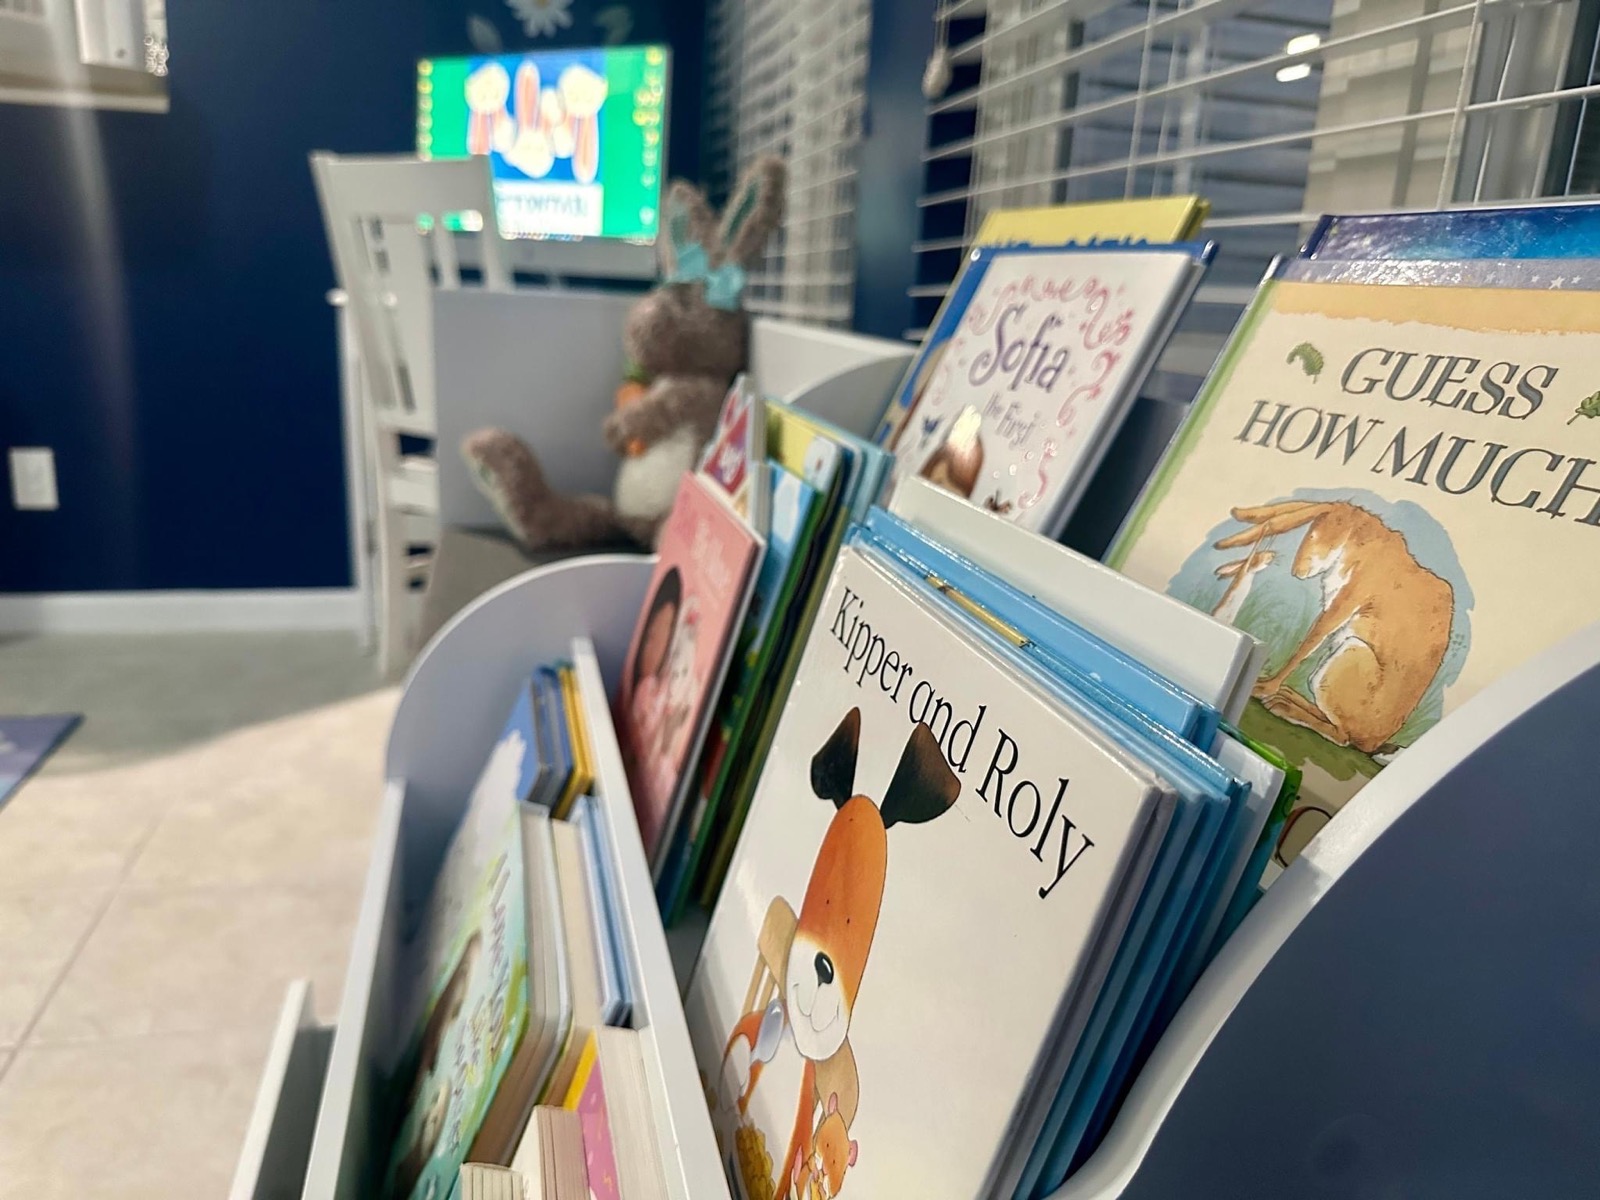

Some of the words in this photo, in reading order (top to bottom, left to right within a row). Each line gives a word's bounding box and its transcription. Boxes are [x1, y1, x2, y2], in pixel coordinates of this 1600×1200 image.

[968, 303, 1070, 393] Sofia
[1340, 348, 1559, 420] GUESS
[997, 402, 1041, 447] First
[1233, 399, 1384, 466] HOW
[1370, 425, 1600, 527] MUCH
[829, 586, 913, 704] Kipper
[908, 680, 987, 774] and
[975, 728, 1095, 900] Roly
